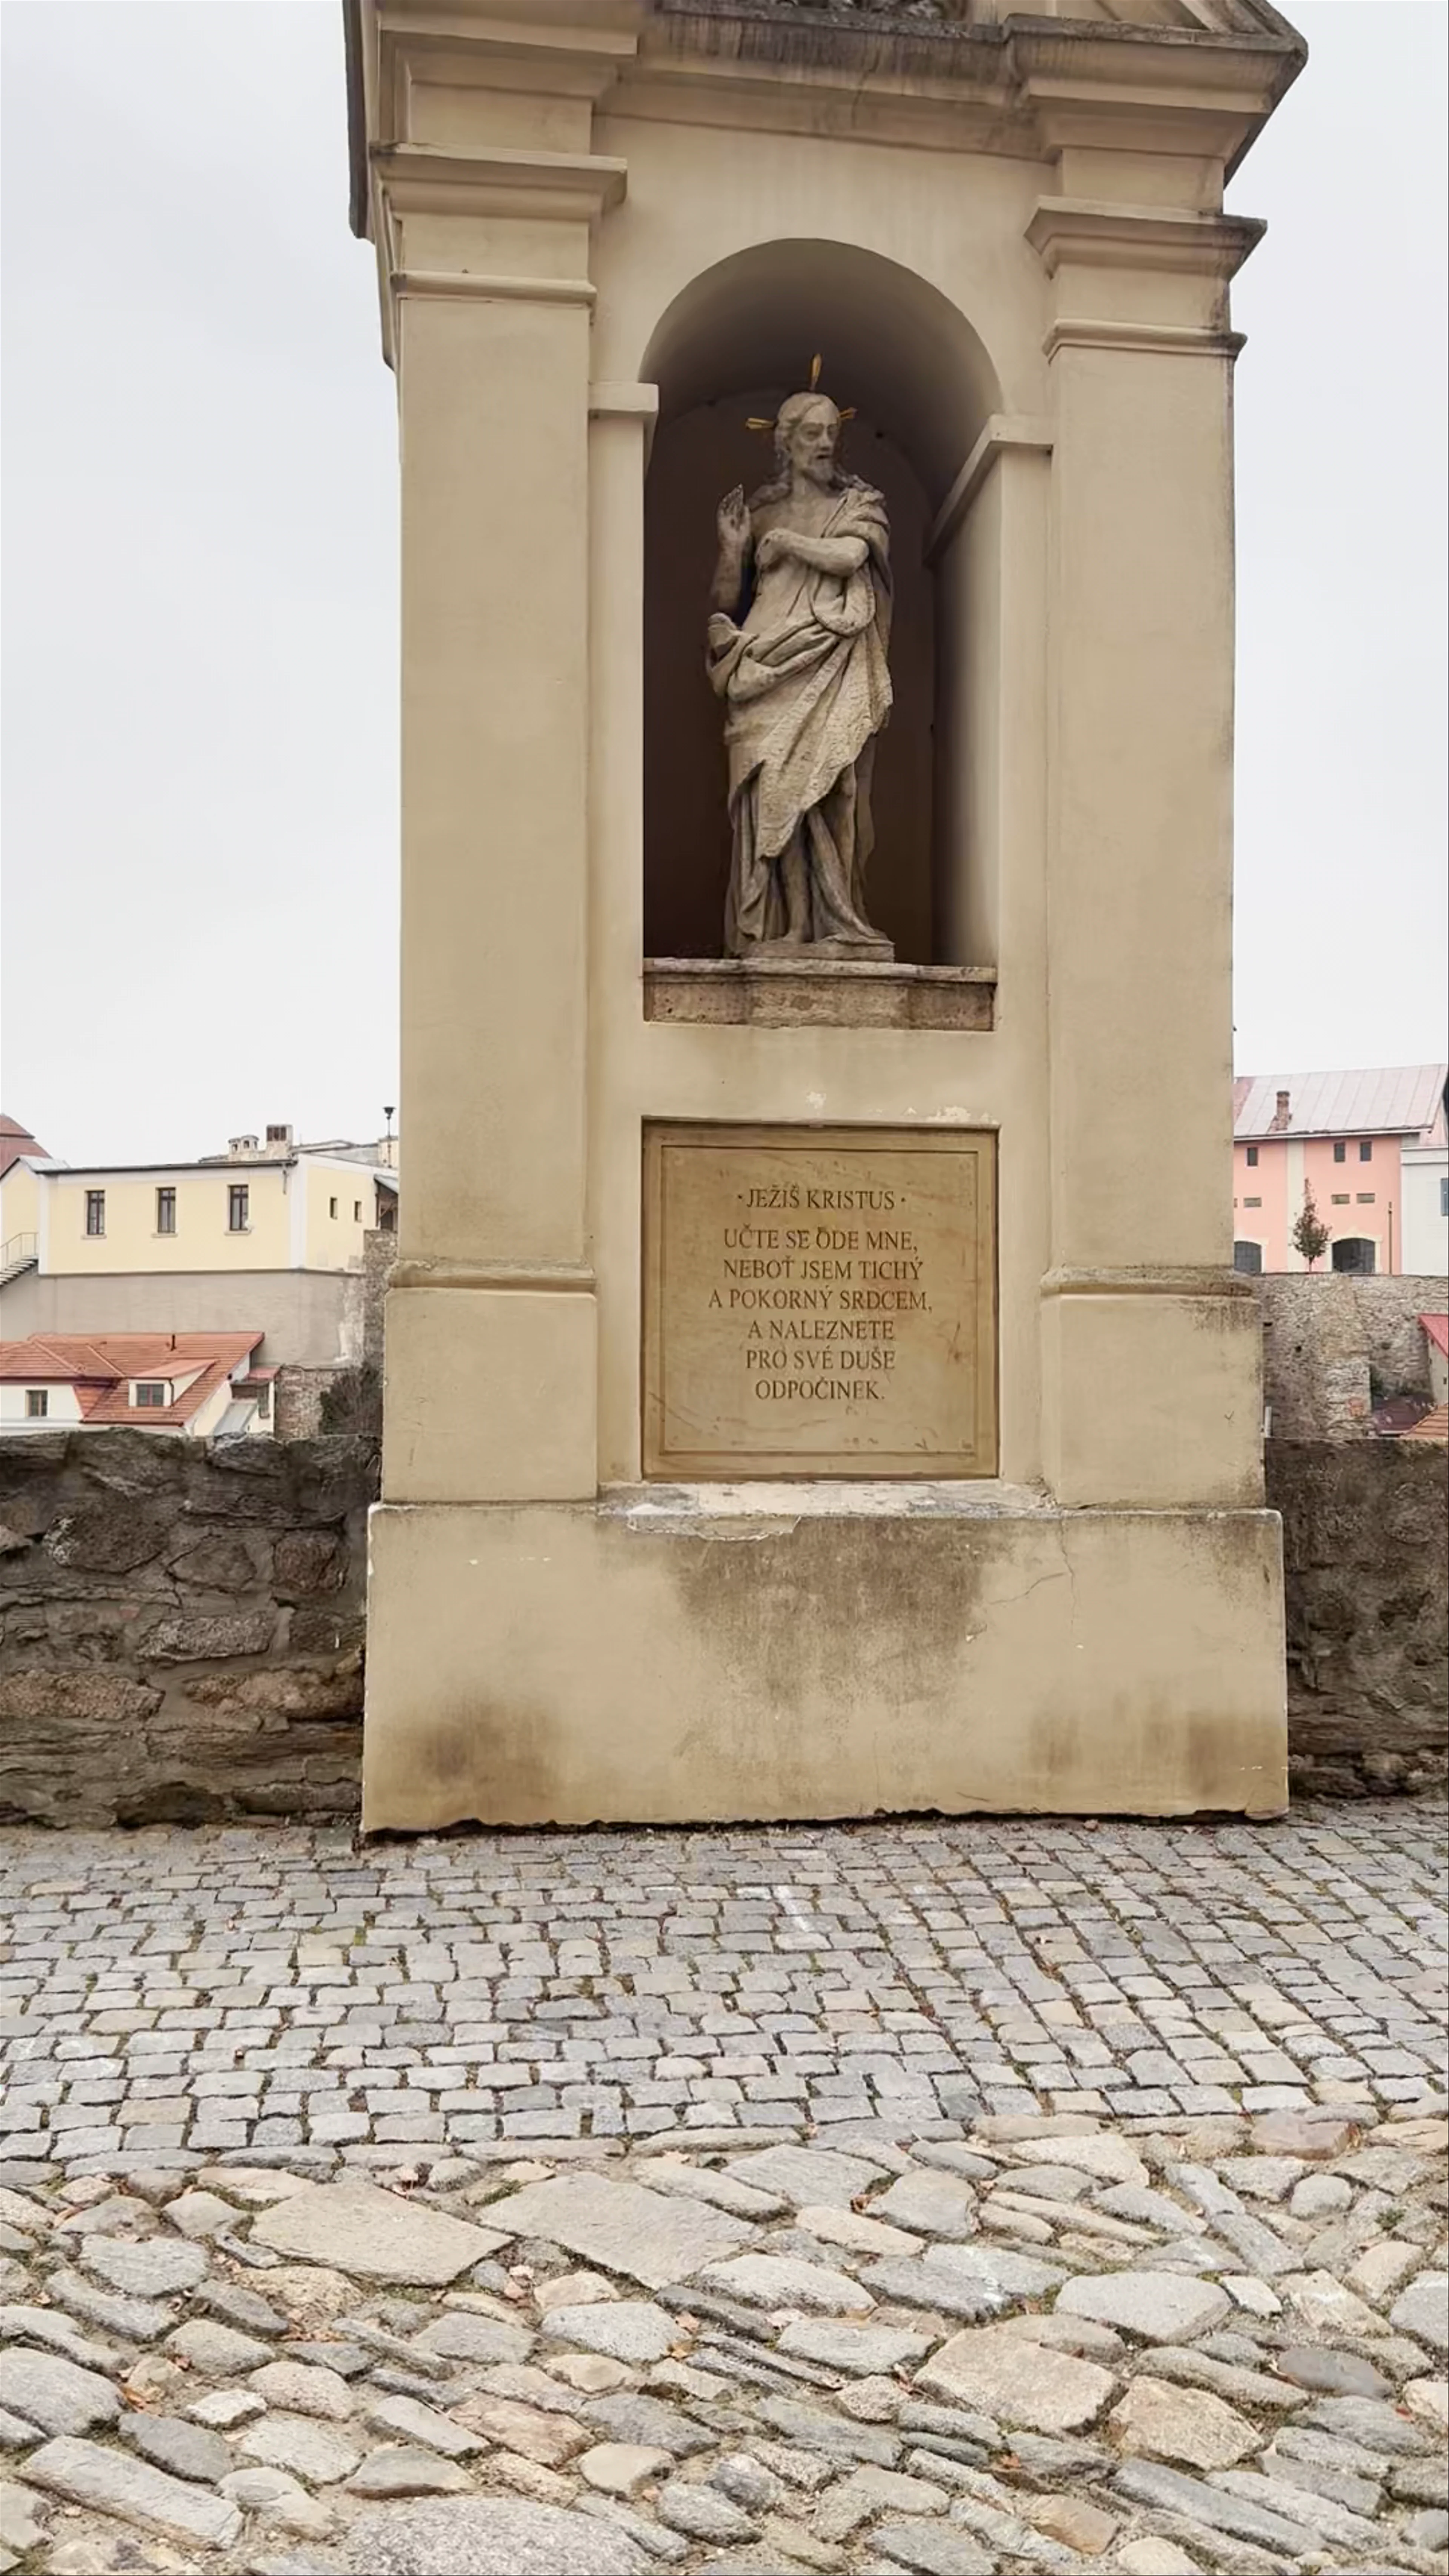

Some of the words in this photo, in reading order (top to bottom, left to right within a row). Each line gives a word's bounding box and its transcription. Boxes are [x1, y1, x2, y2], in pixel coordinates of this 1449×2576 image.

[724, 1225, 779, 1250] UČTE
[786, 1229, 810, 1250] SE
[866, 1231, 918, 1253] MNE,
[723, 1255, 794, 1279] NEBOŤ
[800, 1260, 851, 1280] JSEM
[858, 1256, 923, 1280] TICHÝ
[708, 1289, 722, 1309] A
[730, 1285, 833, 1310] POKORNÝ
[840, 1290, 933, 1313] SRDCEM,
[748, 1320, 763, 1339] A
[769, 1320, 895, 1340] NALEZNETE
[746, 1350, 787, 1369] PRO
[794, 1345, 833, 1370] SVÉ
[841, 1347, 895, 1370] DUŠE
[755, 1375, 885, 1400] ODPOČINEK.
